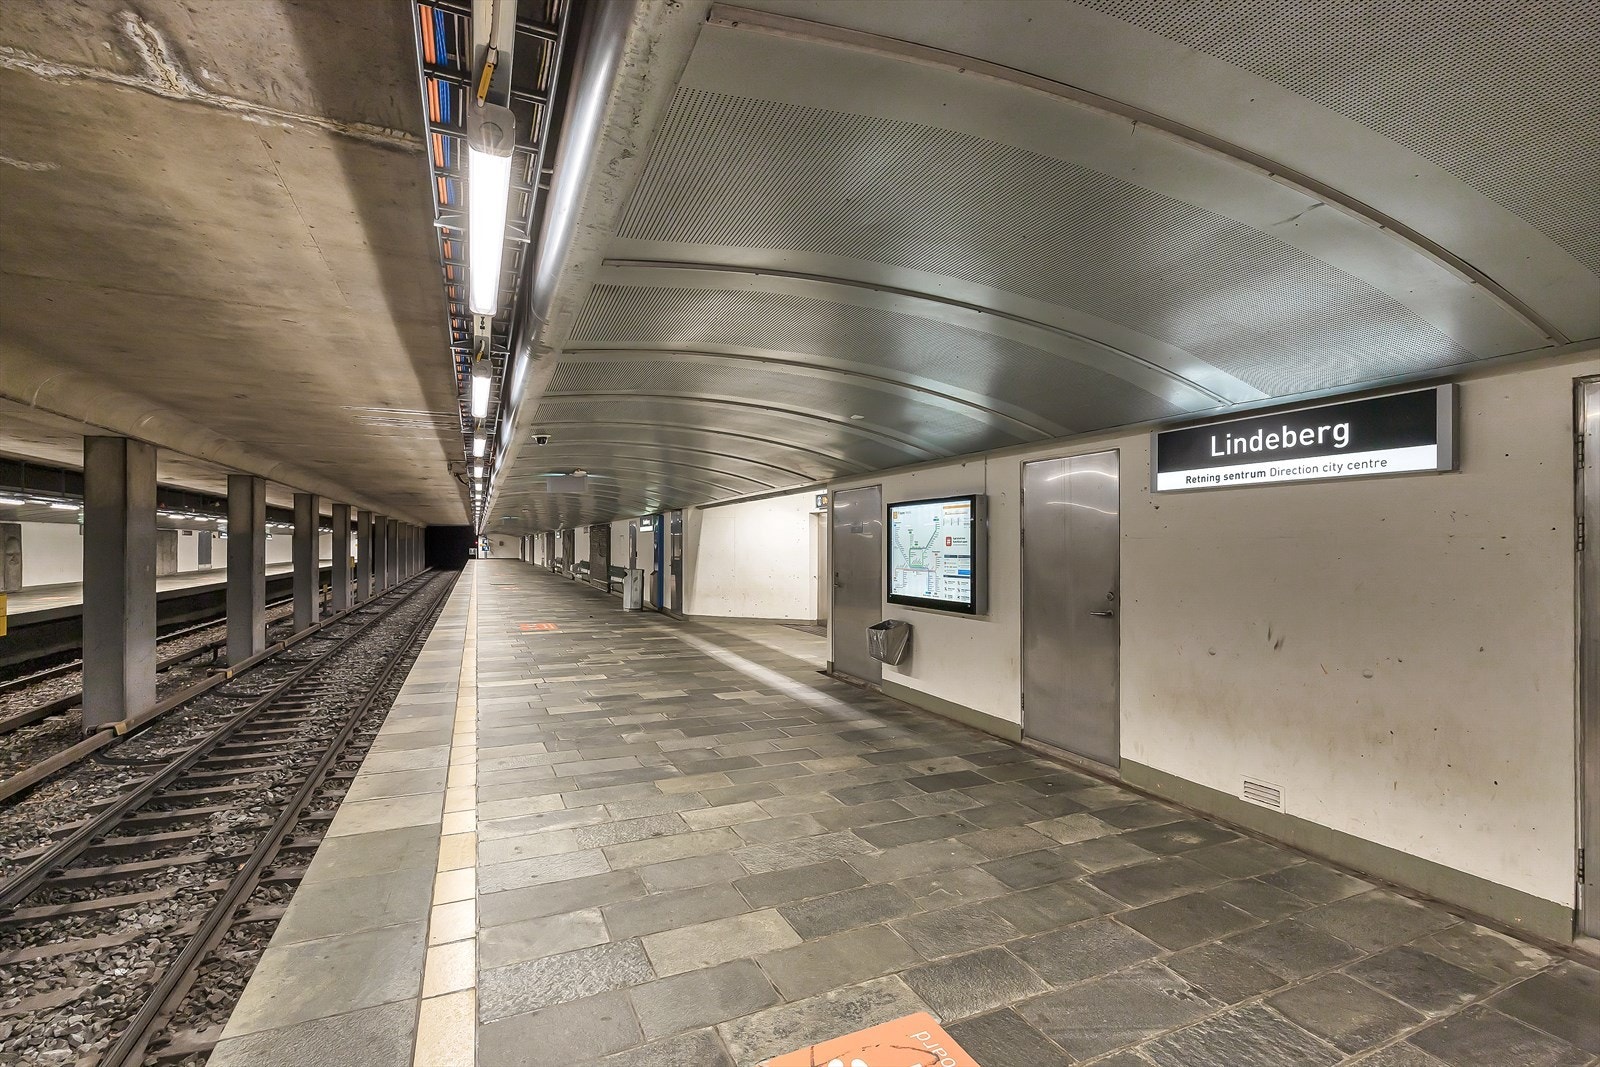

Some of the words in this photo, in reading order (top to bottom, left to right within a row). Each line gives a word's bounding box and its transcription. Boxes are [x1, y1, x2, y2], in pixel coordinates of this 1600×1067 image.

[1211, 422, 1350, 457] Lindeberg
[1185, 474, 1221, 485] Retning
[1223, 470, 1267, 481] sentrum
[1269, 464, 1319, 477] Direction
[1322, 462, 1344, 474] city
[1346, 458, 1388, 471] centre
